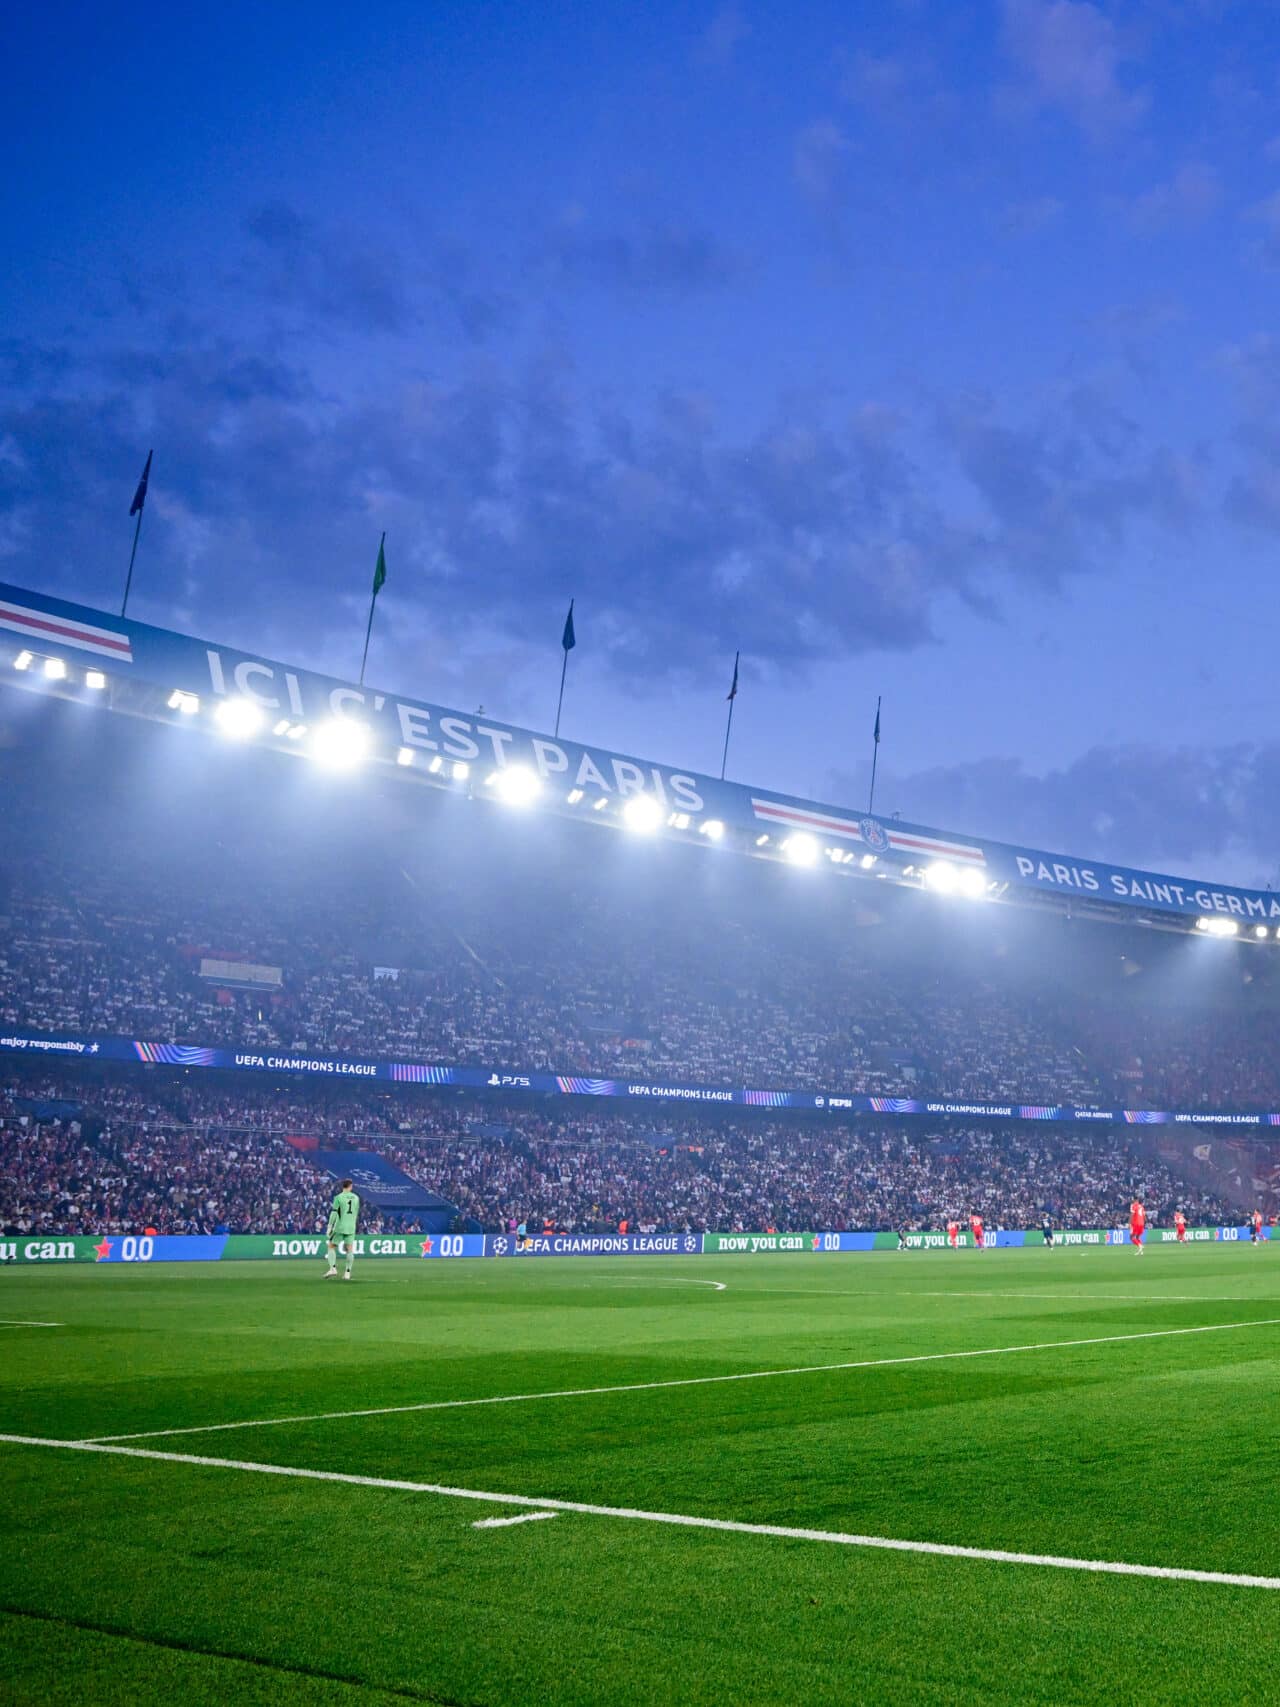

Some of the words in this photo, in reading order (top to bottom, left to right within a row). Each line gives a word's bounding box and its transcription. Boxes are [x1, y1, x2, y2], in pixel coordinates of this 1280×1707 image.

[207, 650, 304, 716] ICI
[531, 738, 704, 812] PARIS
[1016, 856, 1100, 890] PARIS
[0, 1036, 28, 1048] enjoy
[29, 1038, 85, 1053] responsibly
[235, 1054, 264, 1066] UEFA
[267, 1057, 333, 1072] CHAMPIONS
[335, 1063, 377, 1076] LEAGUE
[502, 1076, 530, 1087] PS5
[628, 1084, 650, 1095] UEFA
[651, 1087, 700, 1099] CHAMPIONS
[702, 1091, 733, 1101] LEAGUE
[829, 1098, 852, 1108] PEPSI
[927, 1104, 945, 1112] UEFA
[946, 1104, 986, 1114] CHAMPIONS
[986, 1107, 1012, 1116] LEAGUE
[1175, 1114, 1192, 1122] UEFA
[1192, 1114, 1232, 1123] CHAMPIONS
[1232, 1115, 1260, 1123] LEAGUE
[346, 1200, 353, 1215] 1
[824, 1233, 840, 1251] 0.0
[924, 1235, 945, 1249] you
[1065, 1233, 1082, 1246] you
[1083, 1232, 1099, 1243] can
[1195, 1230, 1210, 1240] can
[1222, 1227, 1238, 1241] 0.0
[24, 1242, 75, 1260] can
[121, 1236, 153, 1261] 0.0
[273, 1240, 322, 1256] now
[369, 1238, 407, 1255] can
[440, 1235, 464, 1256] 0.0
[554, 1237, 629, 1252] CHAMPIONS
[633, 1237, 678, 1250] LEAGUE
[719, 1237, 750, 1250] now
[751, 1237, 777, 1253] you
[779, 1236, 803, 1249] can
